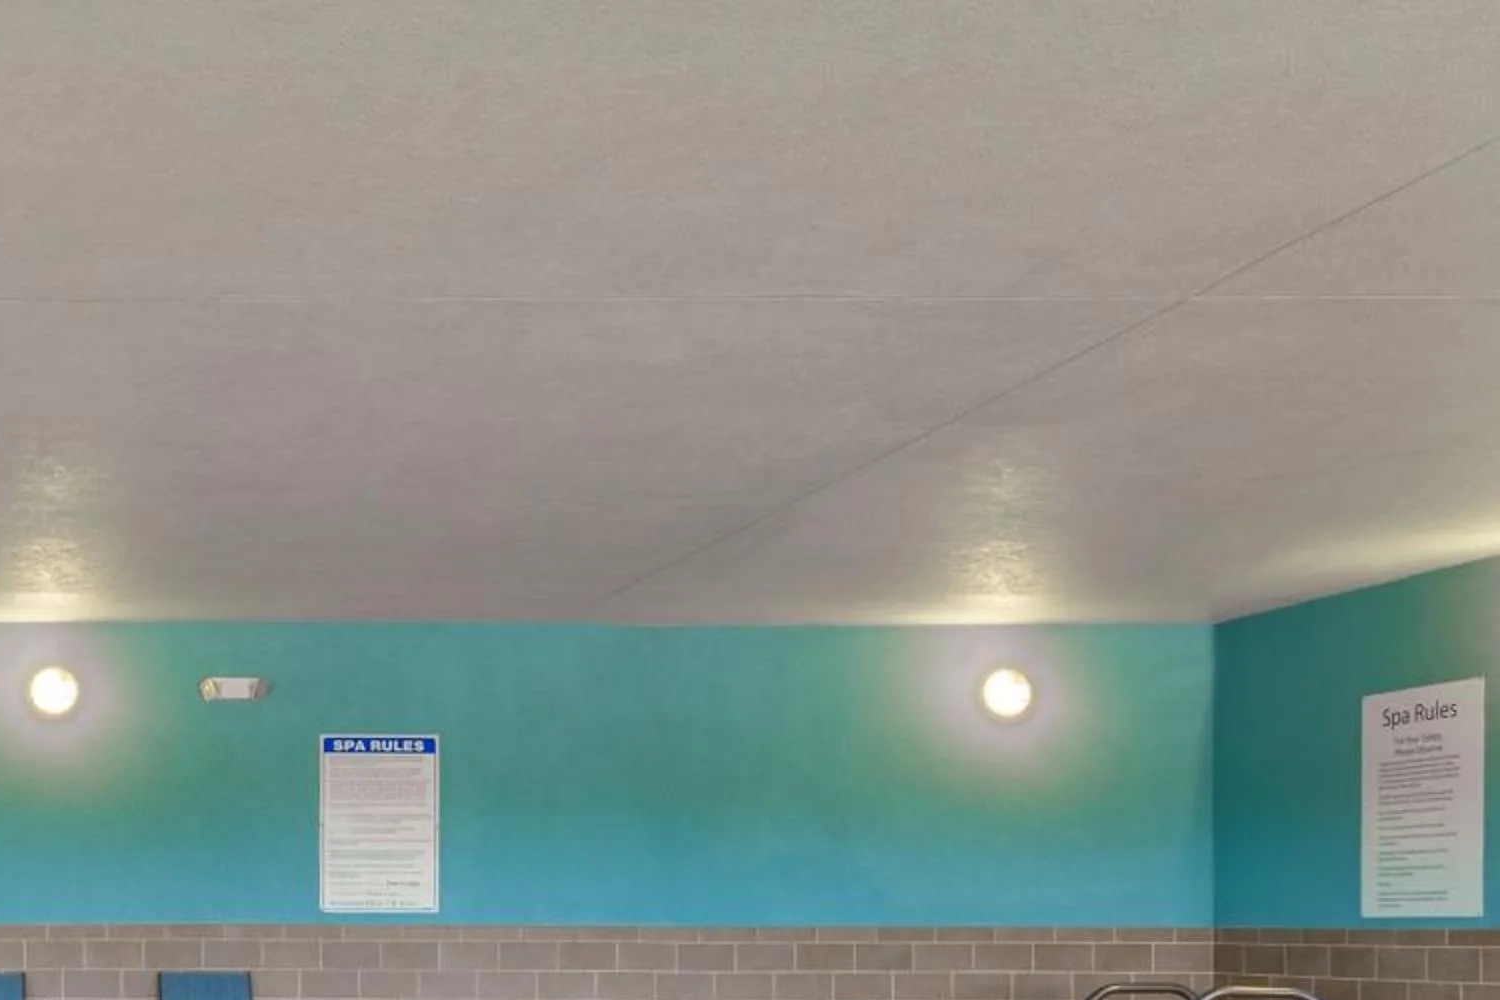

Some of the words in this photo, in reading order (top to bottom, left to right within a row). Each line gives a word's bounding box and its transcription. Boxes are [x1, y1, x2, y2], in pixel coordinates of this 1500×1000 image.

[1381, 707, 1410, 730] Spa
[1414, 699, 1457, 722] Rules
[333, 739, 366, 752] SPA
[370, 739, 425, 752] RULES
